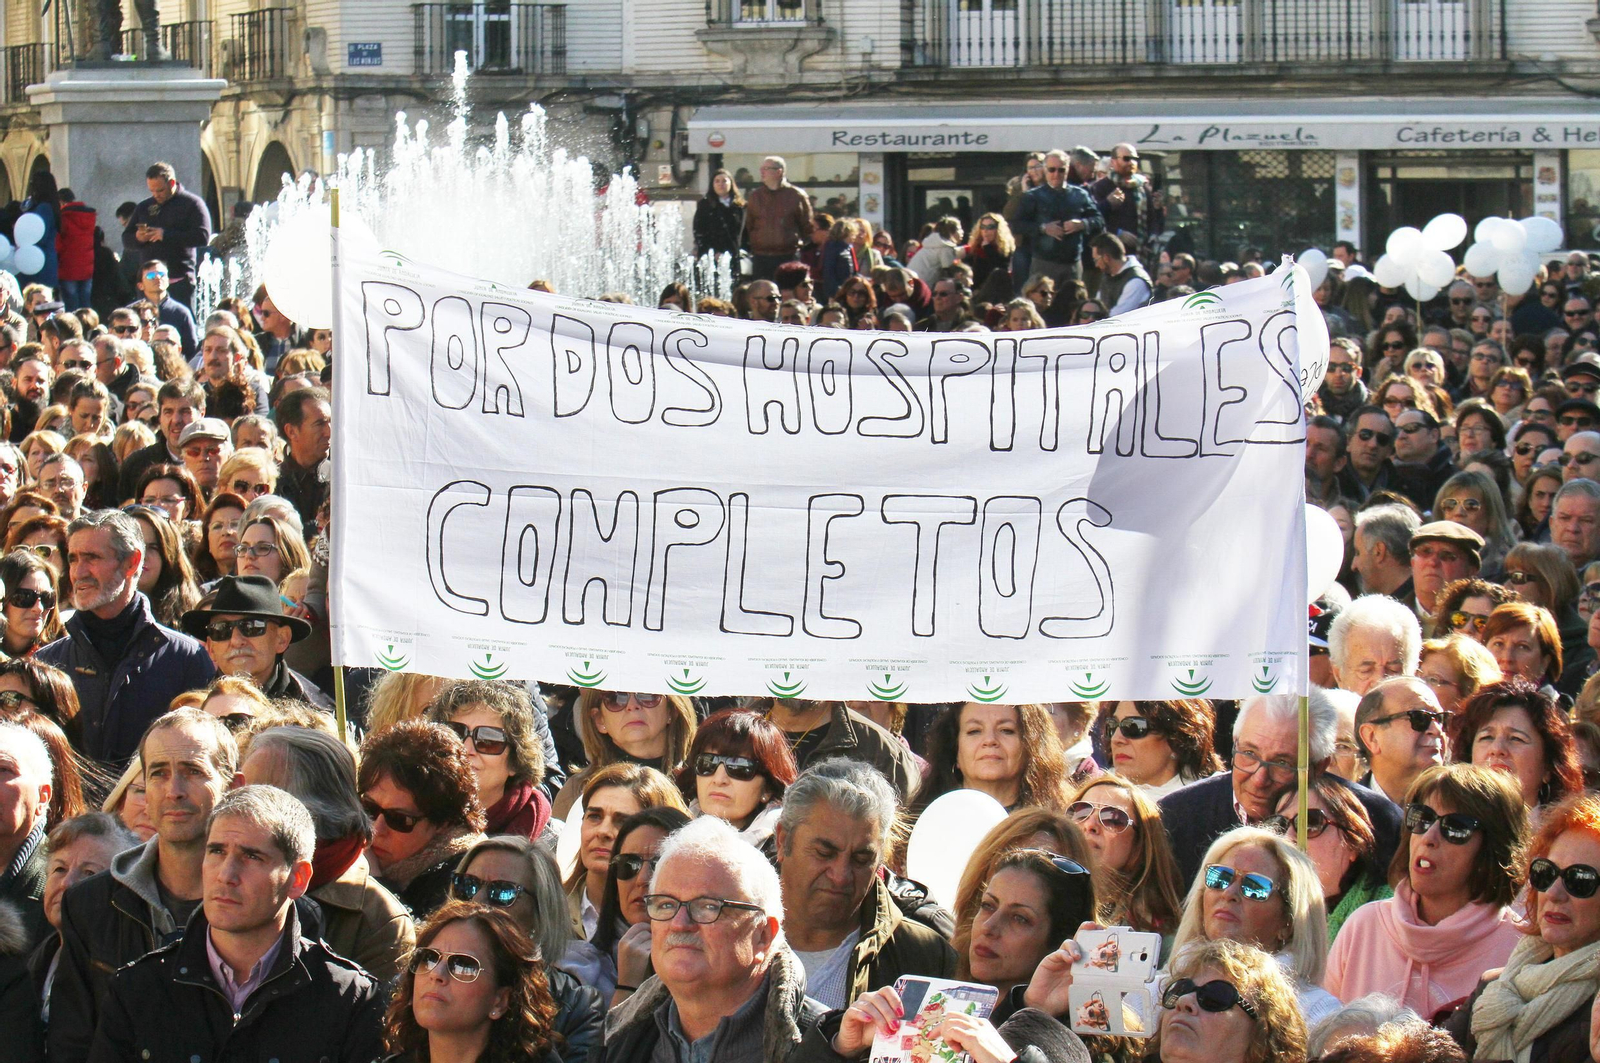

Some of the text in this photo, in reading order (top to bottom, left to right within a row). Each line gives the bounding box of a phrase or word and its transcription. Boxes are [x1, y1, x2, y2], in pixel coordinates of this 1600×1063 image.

[832, 130, 989, 147] Restaurante
[1137, 124, 1319, 144] La Plazuela
[1396, 126, 1600, 143] Cafetería & He
[361, 281, 1306, 458] POR DOS HOSPITALES
[426, 479, 1115, 640] COMPLETOS
